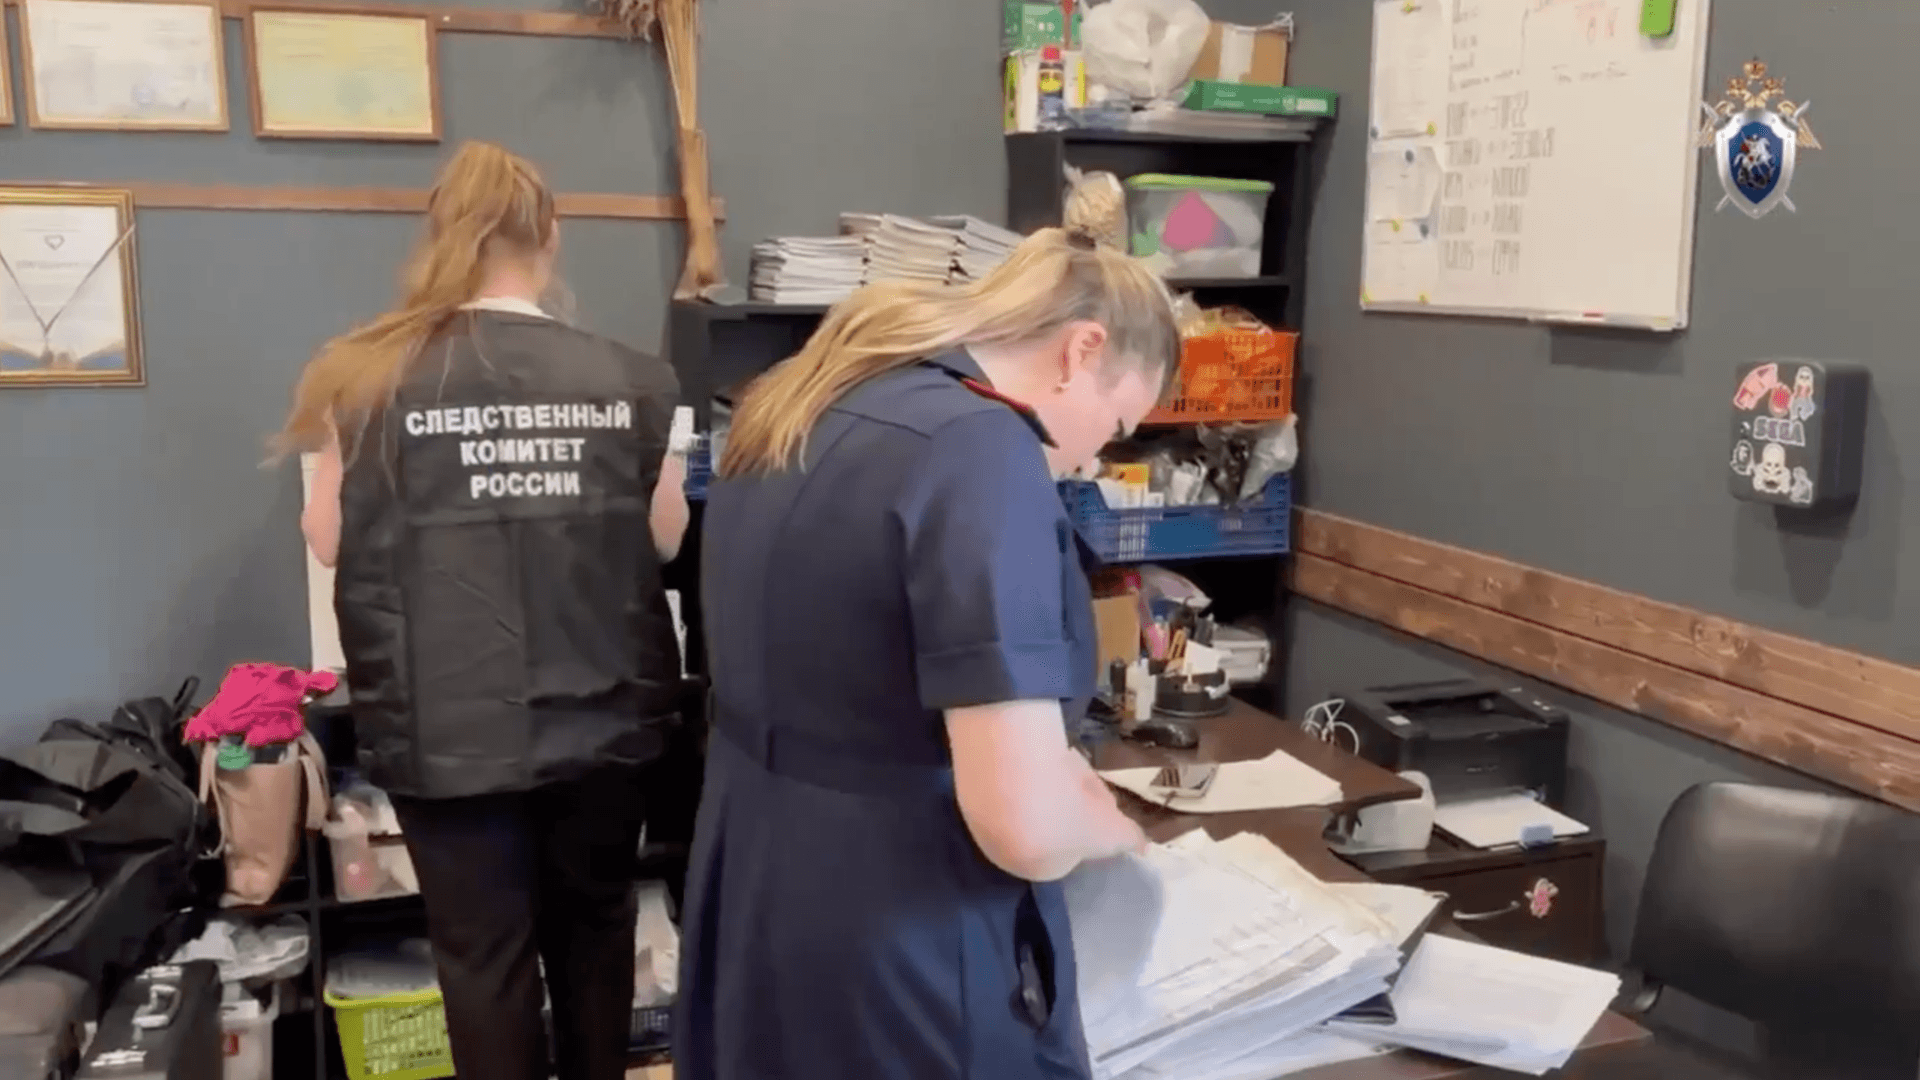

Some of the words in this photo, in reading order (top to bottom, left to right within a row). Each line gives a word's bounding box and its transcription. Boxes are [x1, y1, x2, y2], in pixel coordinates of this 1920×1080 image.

[405, 400, 632, 436] СЛЕДСТВЕННЫЙ
[1752, 415, 1805, 447] SEGA
[460, 437, 586, 466] КОМИТЕТ
[470, 471, 581, 499] РОССИИ
